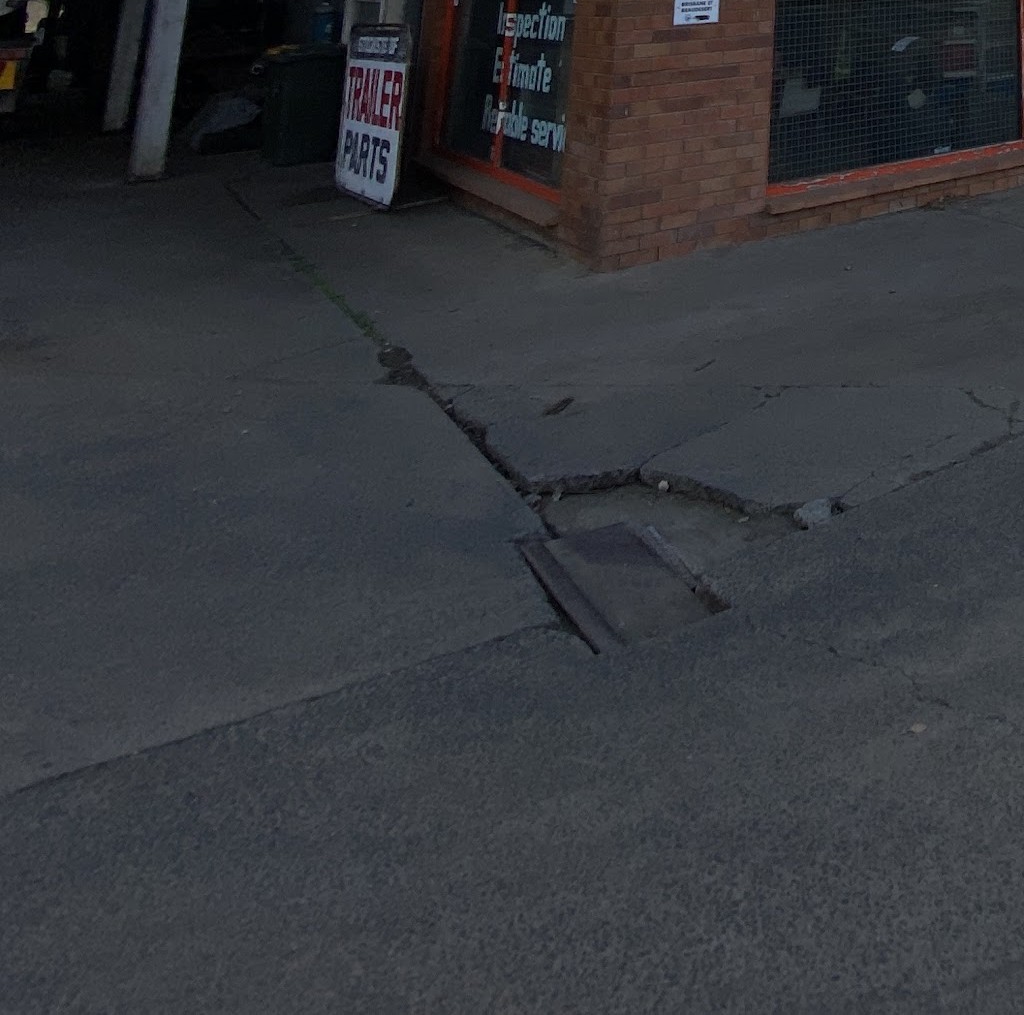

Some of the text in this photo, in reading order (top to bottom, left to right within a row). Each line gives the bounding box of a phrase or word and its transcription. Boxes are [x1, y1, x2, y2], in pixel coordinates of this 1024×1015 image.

[492, 46, 553, 94] Etimate
[345, 66, 403, 131] TRAILER
[342, 129, 391, 184] PARTS
